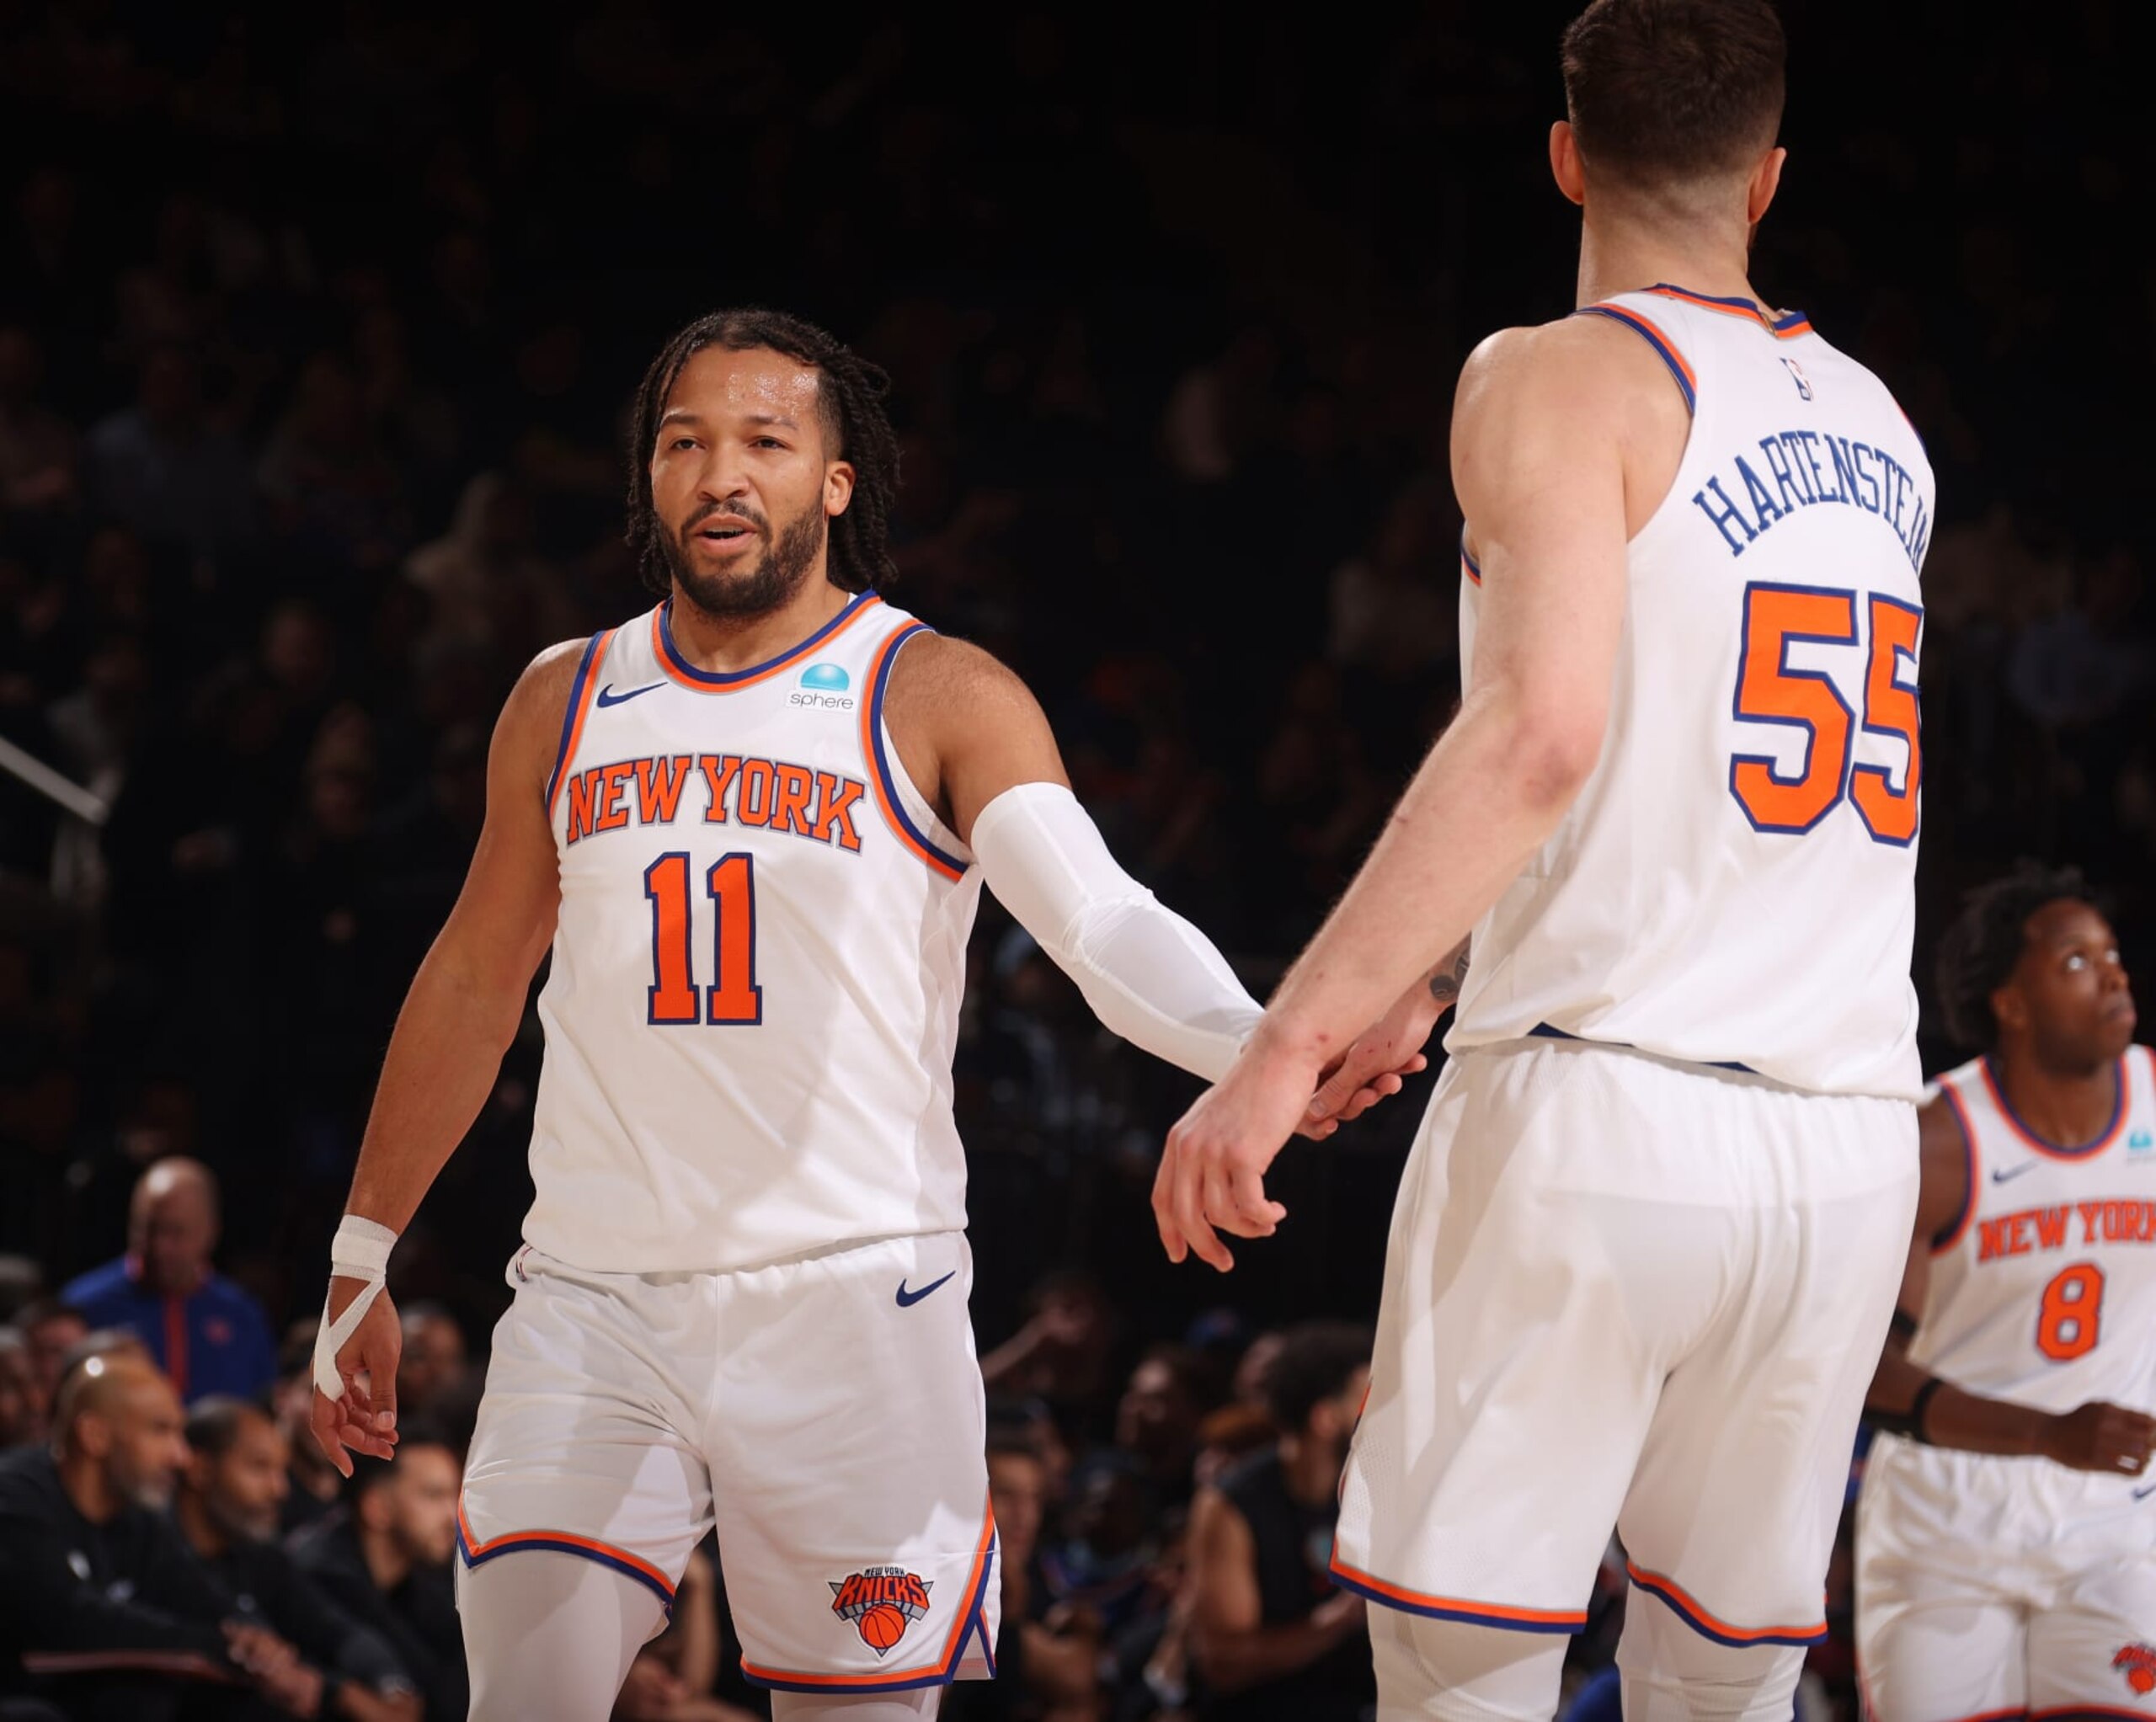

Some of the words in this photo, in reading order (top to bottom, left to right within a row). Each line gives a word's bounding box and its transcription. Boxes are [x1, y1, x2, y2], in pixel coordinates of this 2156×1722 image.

[790, 693, 854, 710] sphere
[1729, 580, 1925, 848] 55
[567, 754, 692, 848] NEW
[699, 754, 865, 854] YORK
[644, 851, 762, 1025] 11
[1977, 1202, 2070, 1263] NEW
[2036, 1261, 2105, 1361] 8
[832, 1573, 930, 1611] KNICKS
[864, 1566, 883, 1576] NEW
[884, 1566, 905, 1576] YORK
